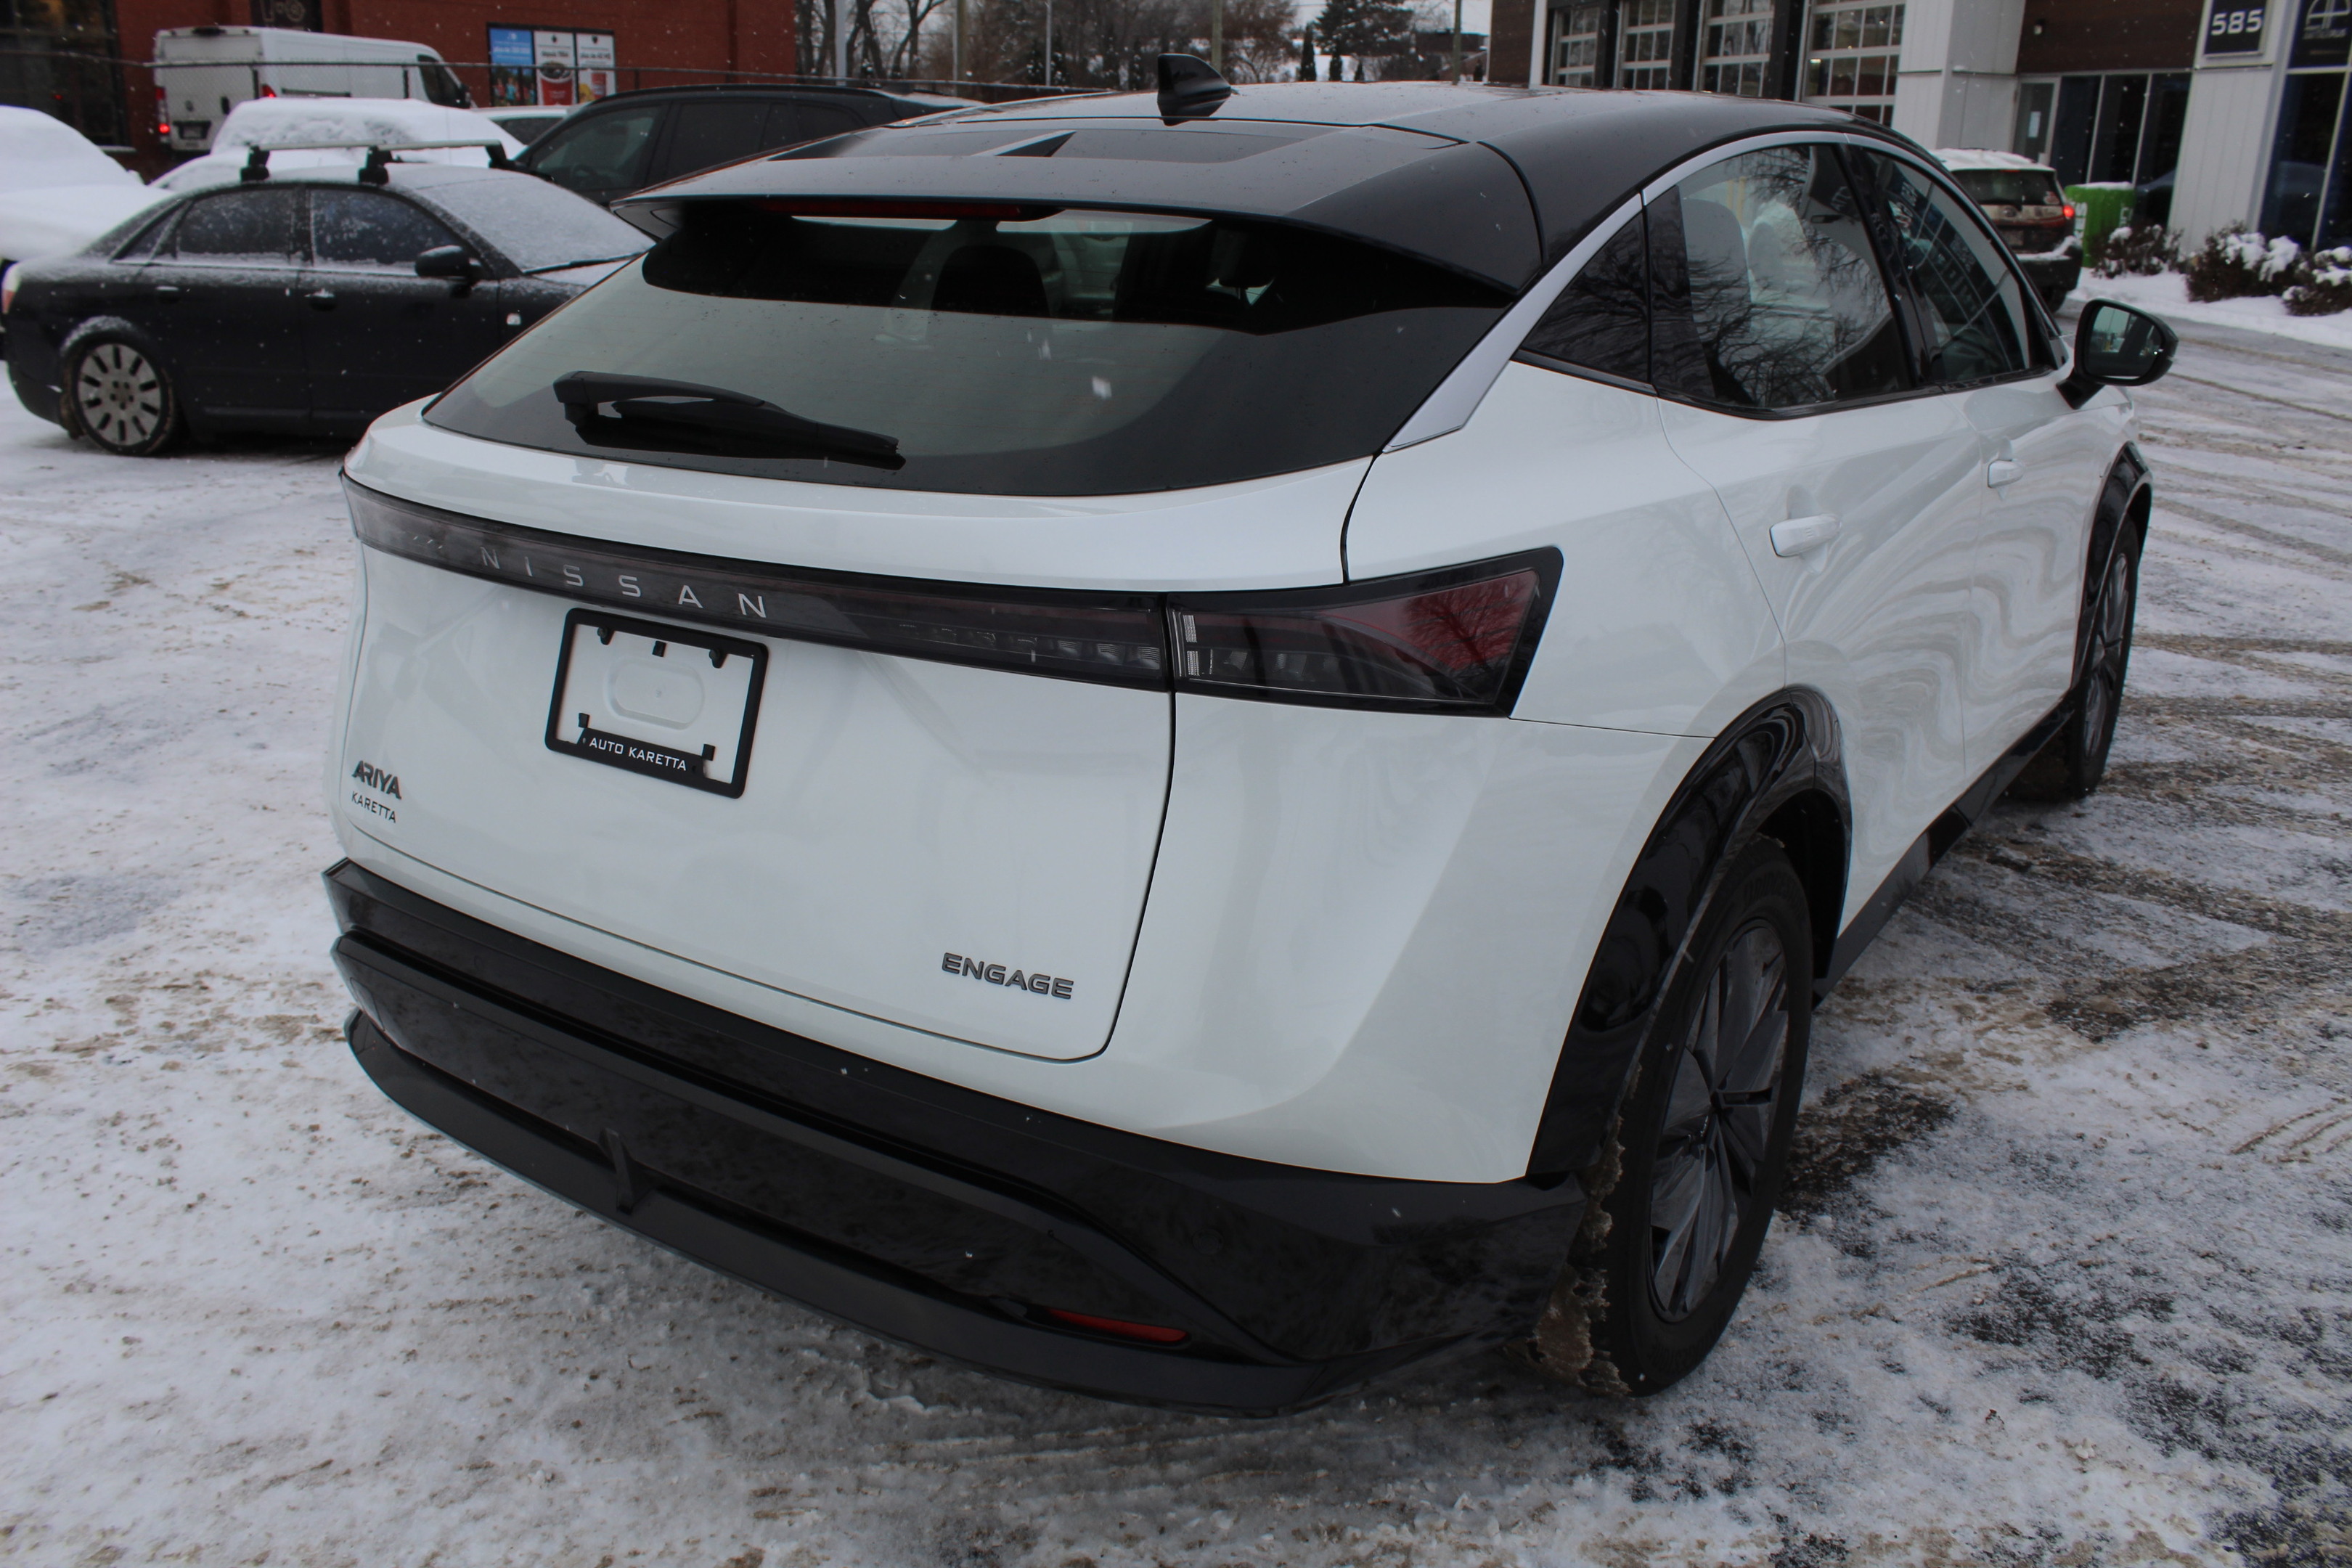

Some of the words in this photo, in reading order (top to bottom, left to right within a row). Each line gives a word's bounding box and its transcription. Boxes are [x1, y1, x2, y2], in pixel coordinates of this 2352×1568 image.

[2210, 8, 2263, 36] 585
[480, 546, 767, 618] NISSAN
[589, 737, 624, 755] AUTO
[628, 746, 687, 772] KARETTA
[351, 760, 401, 800] ARIYA
[351, 791, 396, 824] KARETTA
[942, 952, 1074, 1000] ENGAGE
